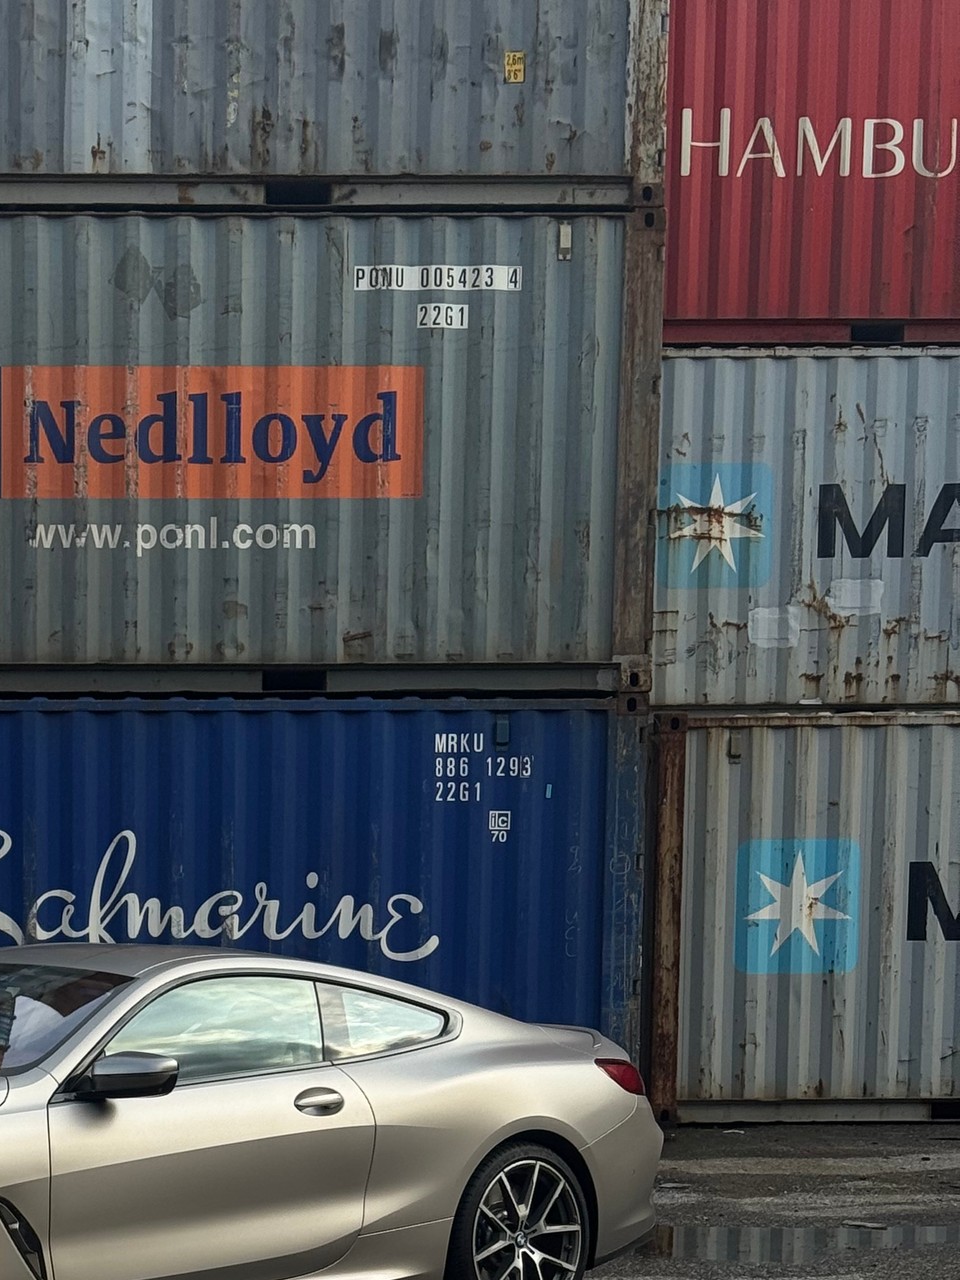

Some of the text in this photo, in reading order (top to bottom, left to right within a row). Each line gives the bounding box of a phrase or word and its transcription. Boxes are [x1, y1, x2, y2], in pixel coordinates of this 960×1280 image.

[680, 108, 958, 178] HAMBU
[356, 267, 519, 288] PONU 005423 4
[419, 305, 464, 326] 22G1
[22, 391, 401, 484] Nedlloyd
[26, 516, 316, 557] www.ponl.com
[435, 733, 484, 753] MRKU
[435, 757, 469, 777] 886
[435, 782, 480, 801] 22G1
[491, 831, 507, 842] 70
